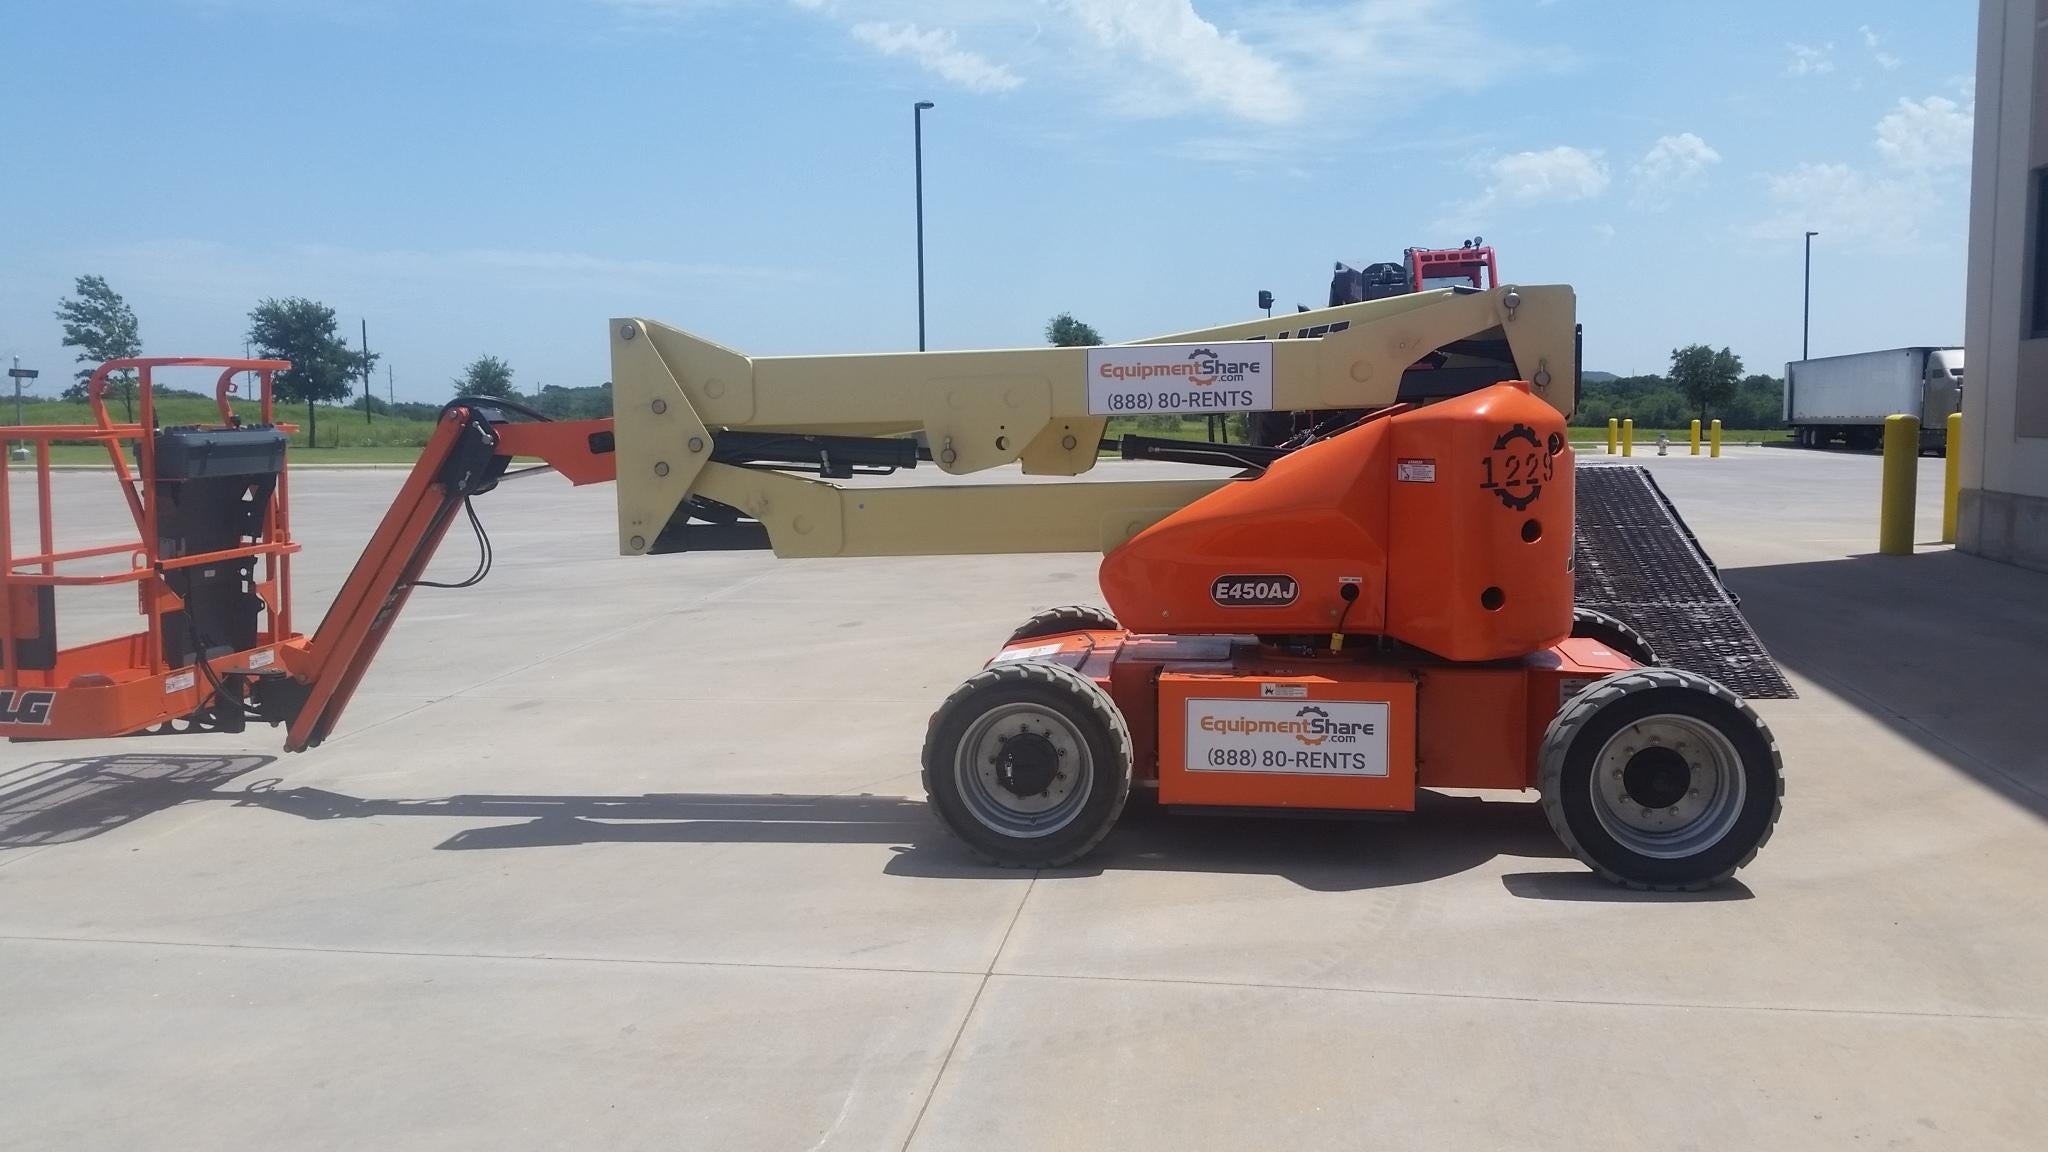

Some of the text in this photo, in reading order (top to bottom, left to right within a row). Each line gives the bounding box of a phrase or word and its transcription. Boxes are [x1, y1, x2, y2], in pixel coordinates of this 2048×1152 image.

[1100, 359, 1260, 381] EquipmentShare
[1218, 373, 1244, 382] .com
[1108, 390, 1253, 411] (888) 80-RENTS
[1480, 452, 1553, 488] 1229
[1215, 582, 1296, 599] E450AJ
[0, 689, 57, 726] LG
[1200, 715, 1374, 736] EquipmentShare
[1328, 733, 1356, 743] .com
[1208, 747, 1366, 769] (888) 80-RENTS
